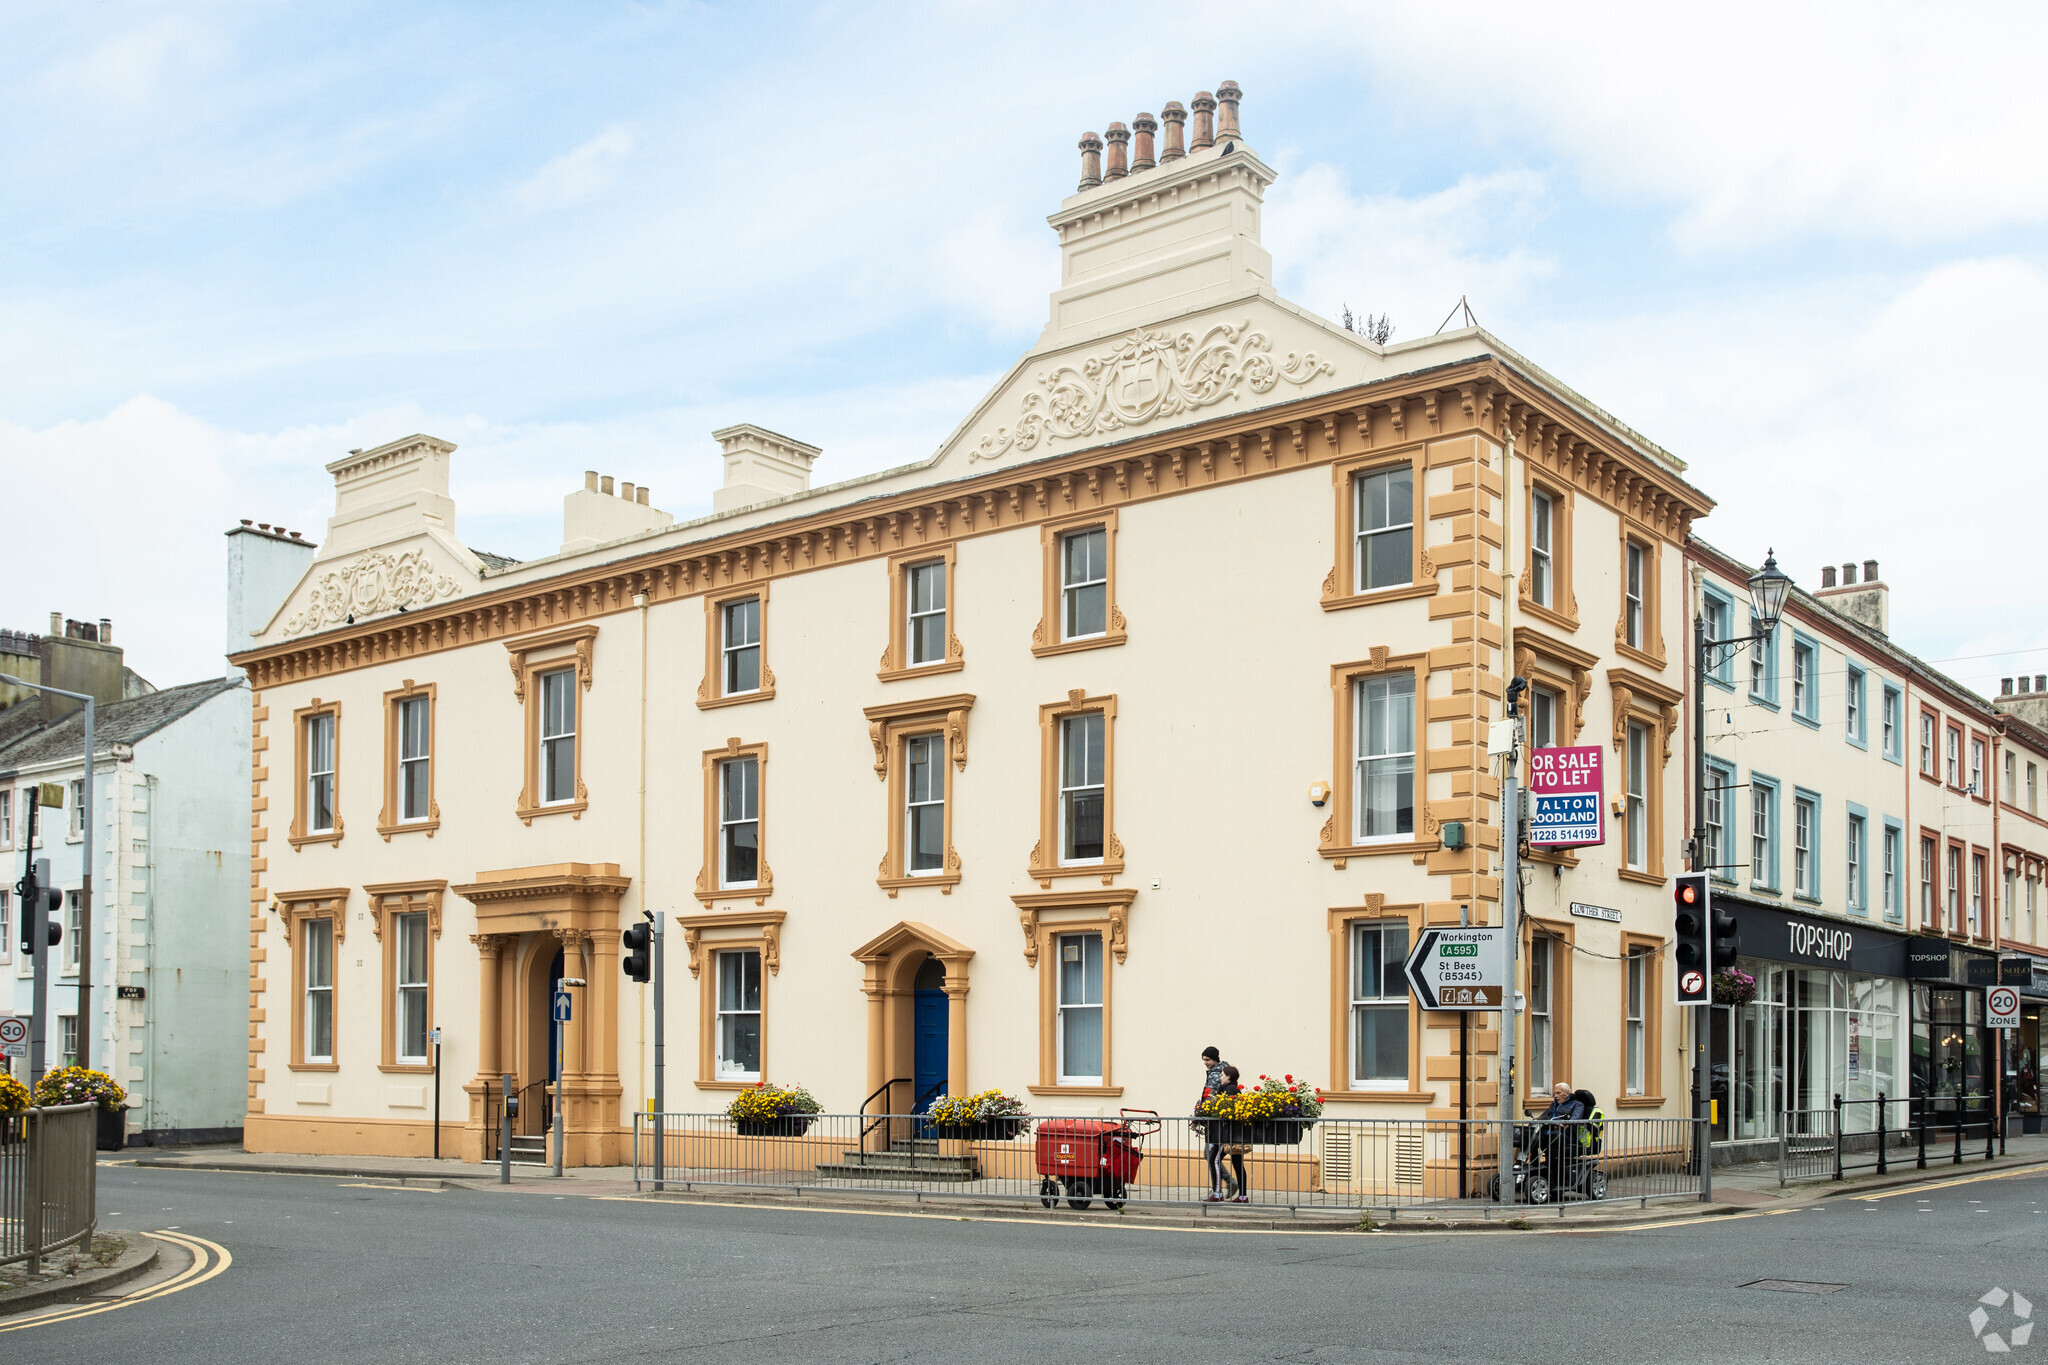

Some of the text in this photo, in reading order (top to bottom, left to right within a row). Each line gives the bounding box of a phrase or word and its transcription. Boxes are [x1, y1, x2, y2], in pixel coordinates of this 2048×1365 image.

[1531, 753, 1598, 770] OR SALE
[1563, 770, 1590, 786] LET
[1536, 799, 1595, 811] ALTON
[1560, 829, 1597, 840] 514199
[1574, 904, 1619, 920] LOWTHER STREET
[1440, 933, 1493, 942] Workington
[1787, 921, 1852, 961] TOPSHOP
[1910, 954, 1947, 962] TOPSHOP
[1439, 962, 1476, 970] St Bees
[2003, 966, 2030, 974] SOLO
[1439, 971, 1483, 981] (B5345)
[1993, 996, 2014, 1008] 20
[1990, 1017, 2017, 1025] ZONE
[2, 1025, 22, 1036] 30
